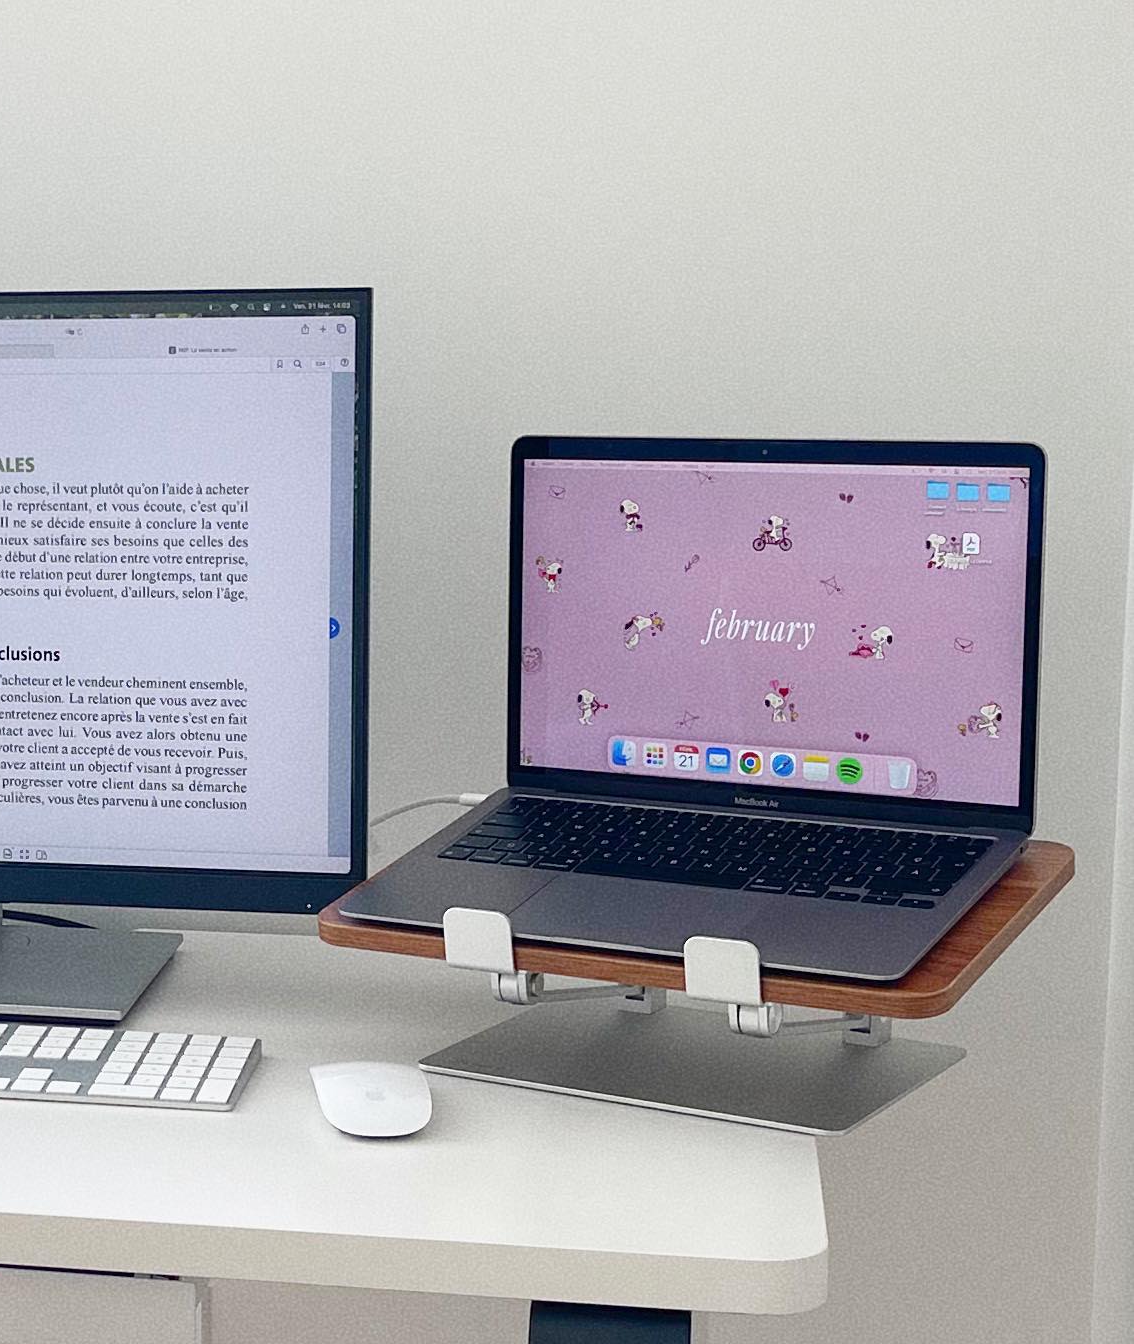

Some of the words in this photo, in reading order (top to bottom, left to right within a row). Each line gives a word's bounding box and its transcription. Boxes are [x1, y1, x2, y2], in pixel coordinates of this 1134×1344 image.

[90, 481, 124, 498] plutôt
[205, 481, 249, 494] acheter
[47, 515, 85, 528] décide
[88, 515, 130, 528] ensuite
[146, 516, 196, 529] conclure
[216, 518, 248, 529] vente
[33, 532, 86, 545] satisfaire
[113, 533, 158, 546] besoins
[189, 534, 223, 547] celles
[4, 549, 36, 562] début
[74, 550, 117, 563] relation
[120, 552, 149, 563] entre
[152, 553, 182, 563] votre
[19, 566, 63, 579] relation
[95, 567, 127, 580] durer
[182, 585, 212, 598] selon
[700, 608, 816, 650] february
[77, 674, 124, 687] vendeur
[126, 675, 186, 688] cheminent
[88, 691, 131, 704] relation
[60, 712, 98, 721] encore
[100, 708, 132, 726] après
[148, 712, 180, 723] vente
[146, 726, 175, 739] alors
[180, 727, 220, 740] obtenu
[27, 740, 58, 753] client
[70, 741, 114, 759] accepté
[29, 757, 66, 770] atteint
[88, 758, 134, 776] objectif
[136, 760, 171, 773] visant
[185, 765, 247, 779] progresser
[678, 754, 693, 768] 21
[2, 777, 63, 791] progresser
[67, 777, 97, 788] votre
[102, 776, 134, 789] client
[188, 778, 247, 792] démarche
[102, 797, 148, 810] parvenu
[184, 795, 247, 809] conclusion
[734, 796, 768, 806] MacBook
[769, 800, 779, 808] Air
